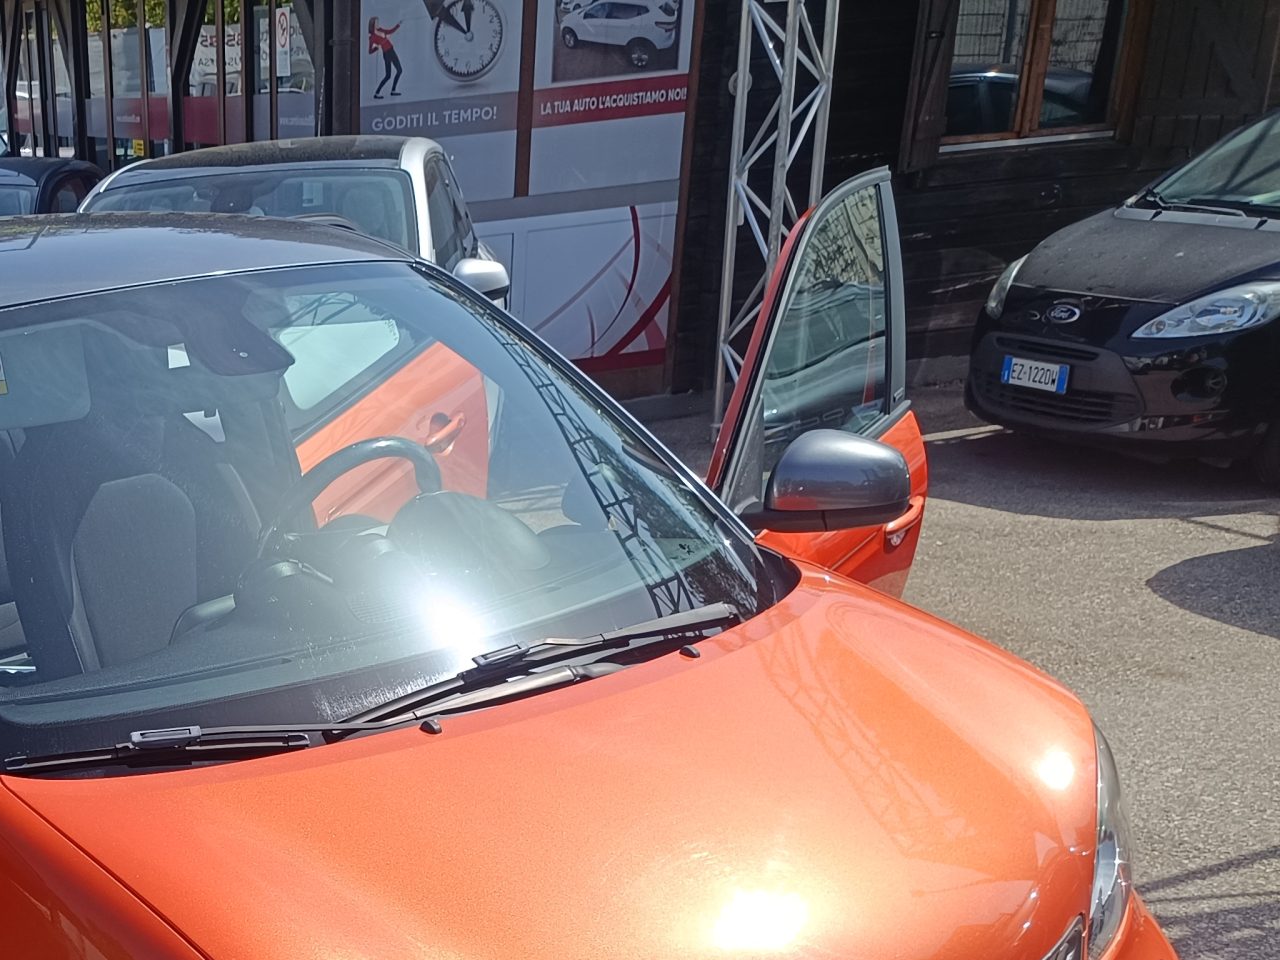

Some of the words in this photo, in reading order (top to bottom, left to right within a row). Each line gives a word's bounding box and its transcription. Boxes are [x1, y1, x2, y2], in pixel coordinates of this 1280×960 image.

[540, 103, 552, 115] LA
[554, 100, 570, 113] TUA
[573, 98, 597, 112] AUTO
[372, 114, 423, 132] GODITI
[427, 113, 440, 126] IL
[443, 107, 497, 124] TEMPO!
